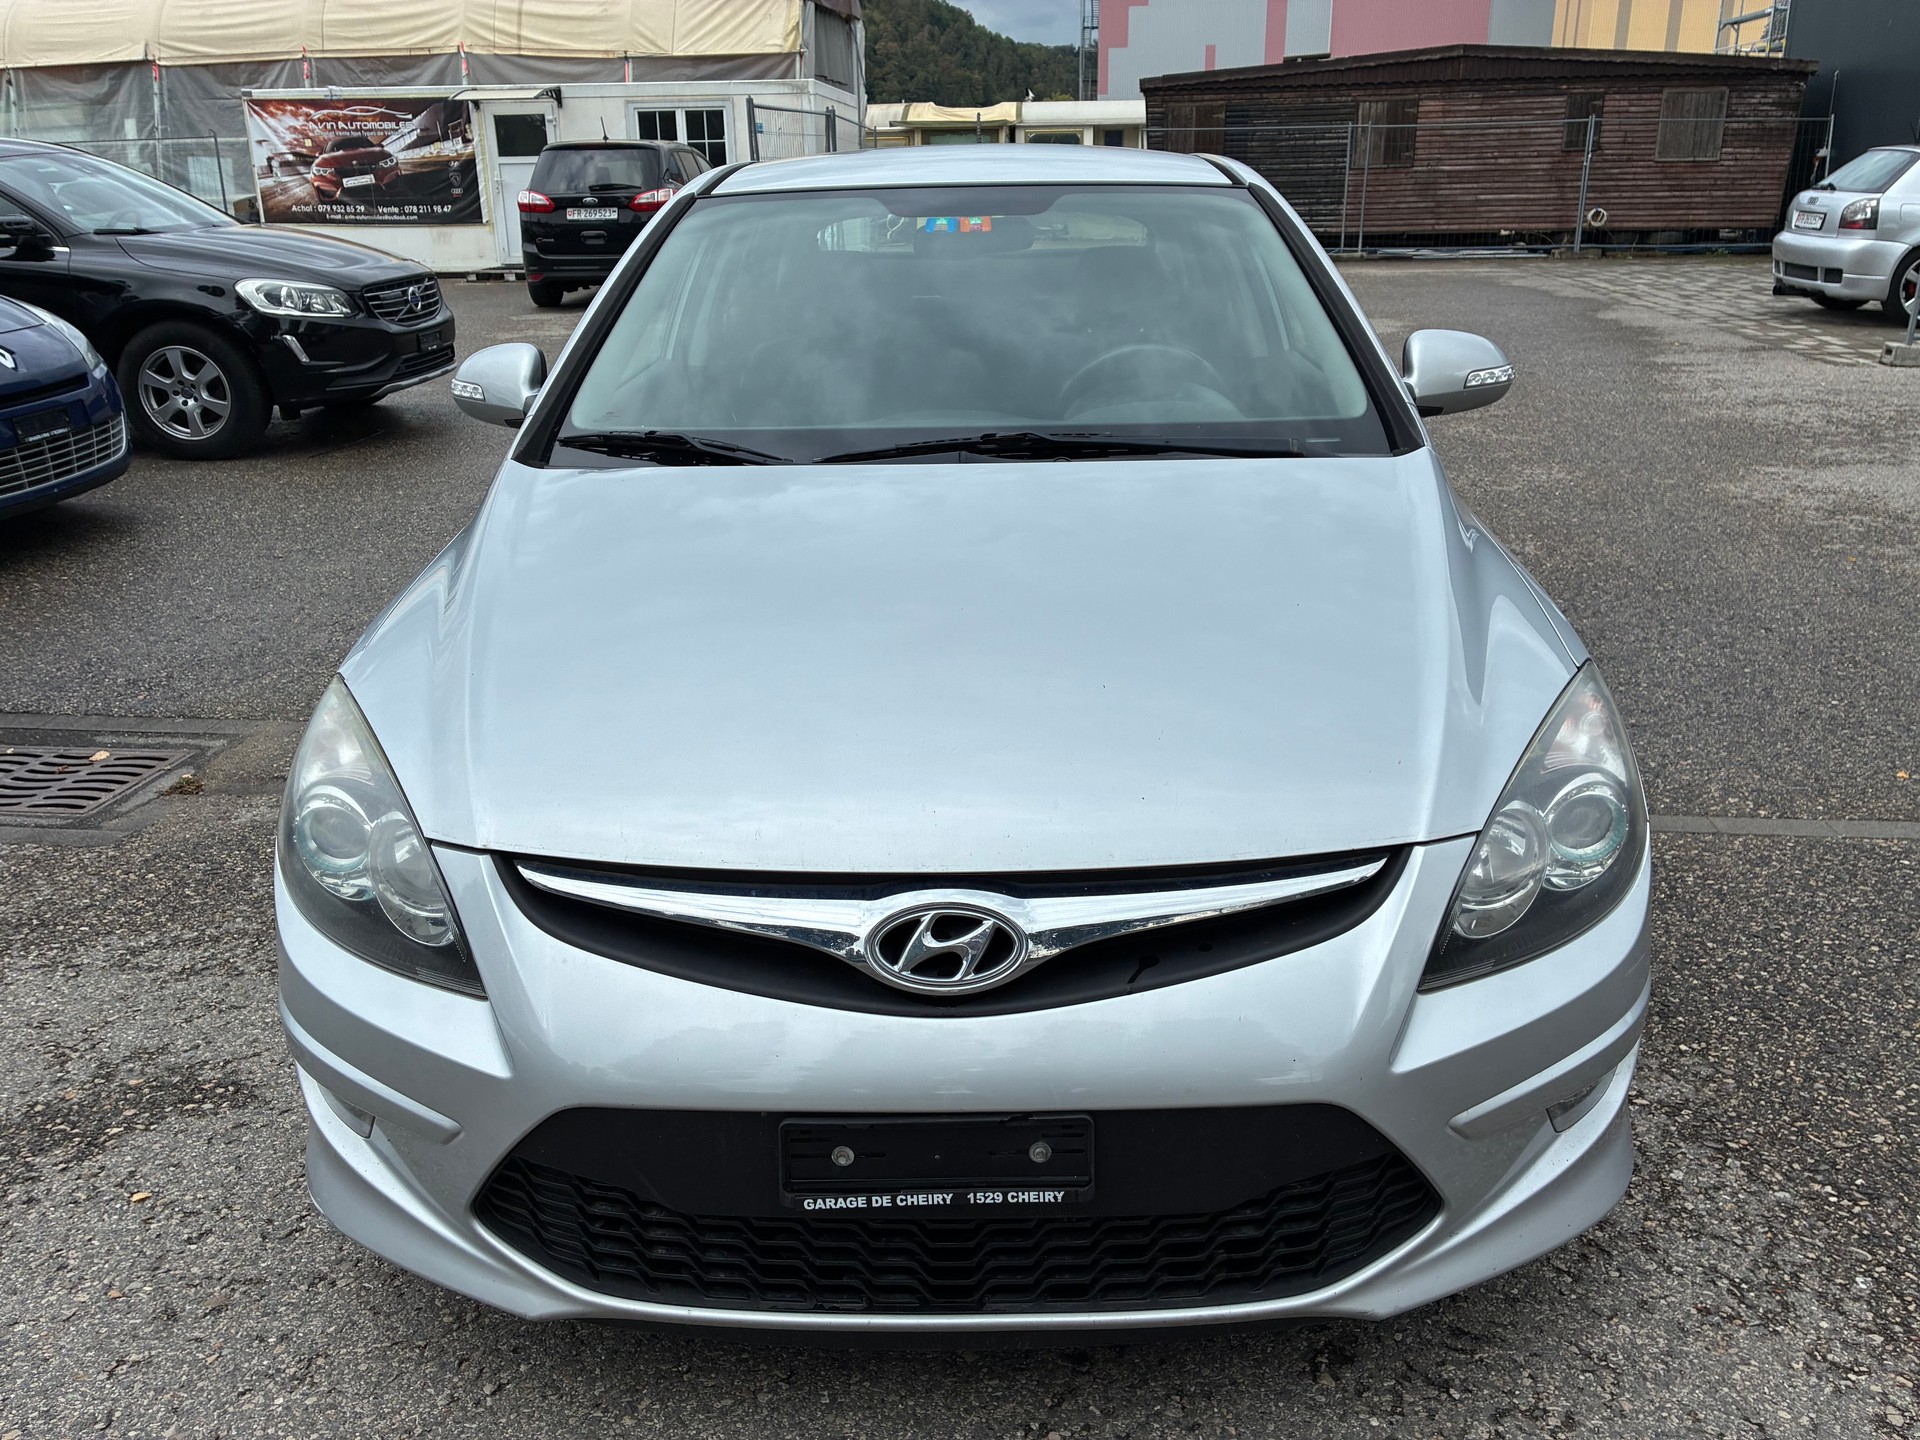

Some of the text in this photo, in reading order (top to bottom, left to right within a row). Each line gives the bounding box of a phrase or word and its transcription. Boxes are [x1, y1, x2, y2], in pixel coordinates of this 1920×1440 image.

[317, 204, 331, 213] 079
[332, 204, 345, 213] 932
[355, 205, 365, 213] 29
[377, 205, 400, 213] Vente
[404, 205, 418, 213] 078
[418, 205, 431, 213] 211
[432, 204, 442, 213] 98
[443, 204, 452, 213] 47
[803, 1191, 1066, 1210] GARAGE DE CHEIRY 1529 CHEIRY
